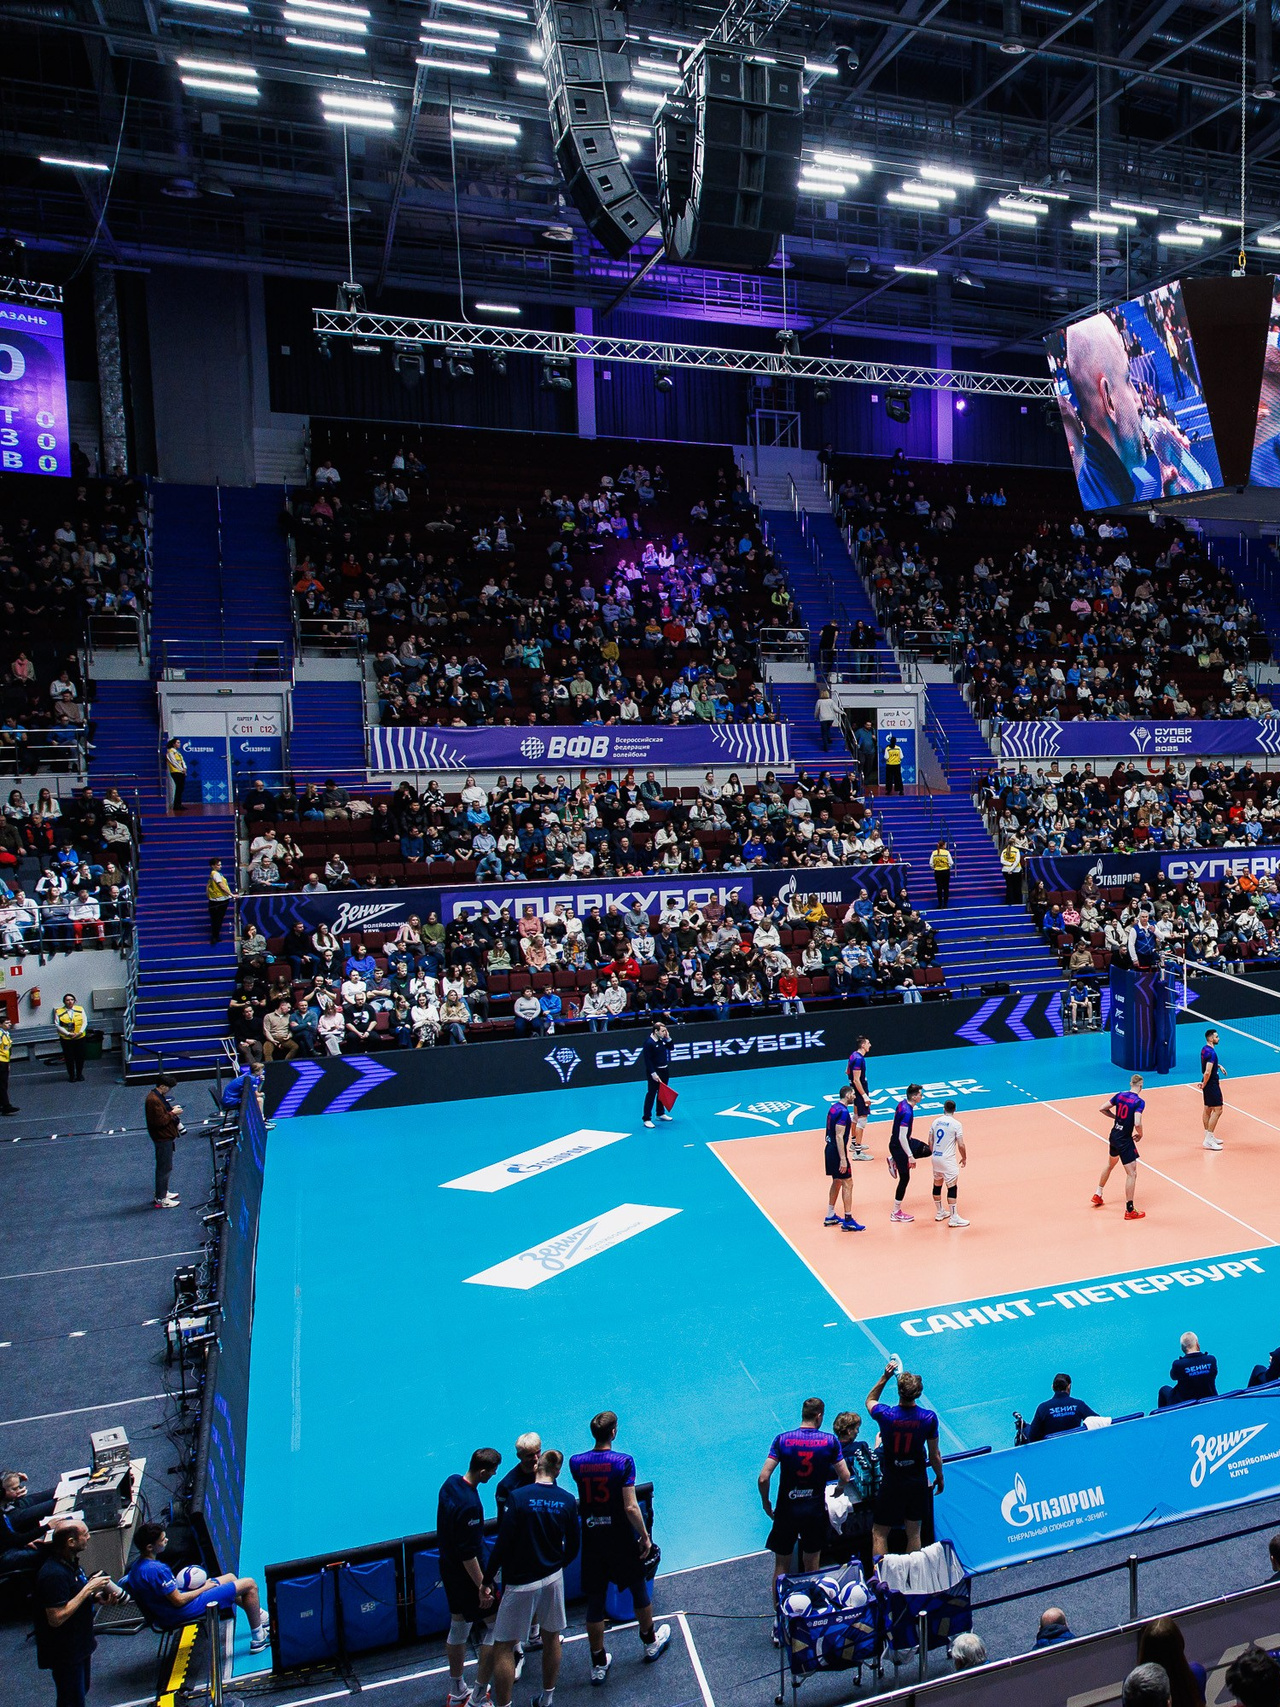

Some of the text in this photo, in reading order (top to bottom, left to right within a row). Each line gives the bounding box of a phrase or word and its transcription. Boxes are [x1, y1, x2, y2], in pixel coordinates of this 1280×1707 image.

[36, 411, 55, 429] 0
[37, 433, 56, 451] 0
[38, 454, 58, 472] 0
[615, 736, 664, 744] Всероссийская
[1154, 727, 1193, 736] СУПЕР
[1154, 736, 1193, 744] КУБОК
[547, 735, 610, 759] ВФВ
[331, 902, 406, 936] Зенит
[595, 1029, 826, 1069] СУЕРКУБОК
[1115, 1102, 1129, 1120] 10
[936, 1127, 945, 1145] 9
[518, 1221, 599, 1271] Зенит
[900, 1257, 1266, 1337] САНКТ-ПЕТЕРБУРГ
[1184, 1363, 1212, 1374] ЗЕНИТ
[1049, 1405, 1078, 1415] ЗЕНИТ
[893, 1431, 913, 1455] 11
[796, 1450, 814, 1477] 3
[1190, 1422, 1269, 1489] Зенит
[1229, 1467, 1250, 1479] КЛУБ
[581, 1477, 610, 1503] 13
[528, 1499, 565, 1508] ЗЕНИТ
[1032, 1486, 1106, 1523] ГАЗПРОМ
[1007, 1511, 1108, 1543] ГЕНЕРАЛЬНЫЙ СПОНСОР ВК «ЗЕНИТ»
